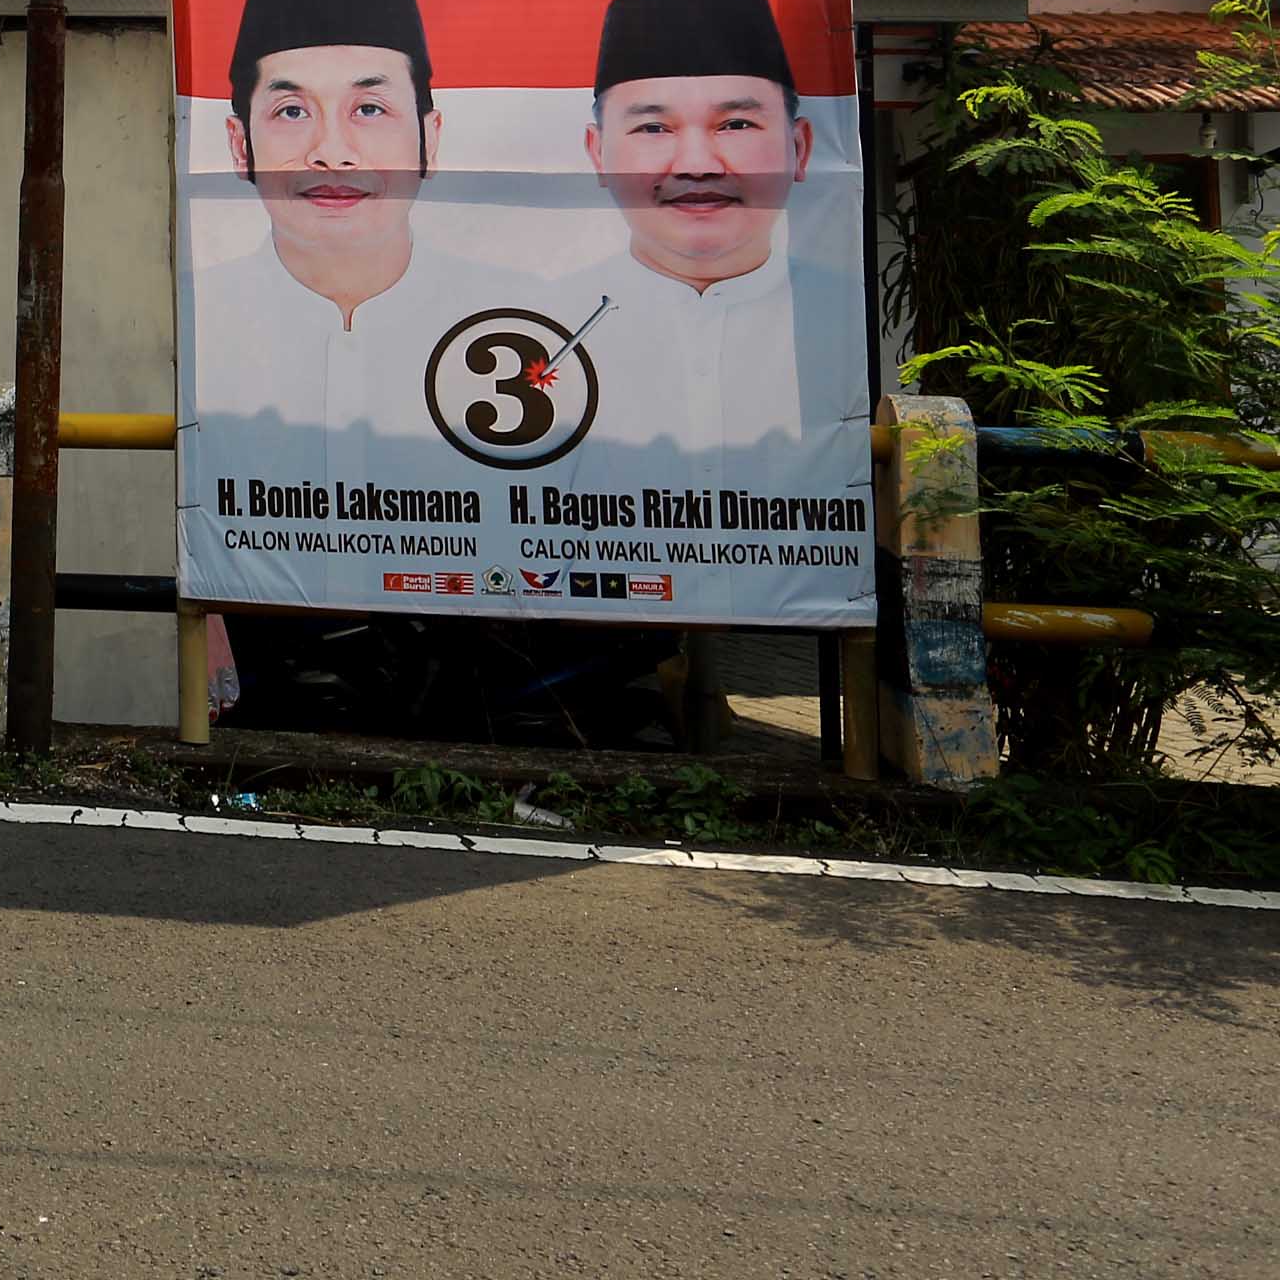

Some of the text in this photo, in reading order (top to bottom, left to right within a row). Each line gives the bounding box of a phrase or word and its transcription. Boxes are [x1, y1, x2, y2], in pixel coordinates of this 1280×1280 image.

[464, 332, 556, 446] 3
[218, 478, 481, 524] H. Bonie Laksmana
[509, 485, 867, 532] H. Bagus Rizki Dinarwan
[224, 529, 477, 557] CALON WALIKOTA MADIUN
[520, 538, 860, 567] CALON WAKIL WALIKOTA MADIUN
[403, 575, 430, 583] Partai
[632, 583, 664, 591] HANURA
